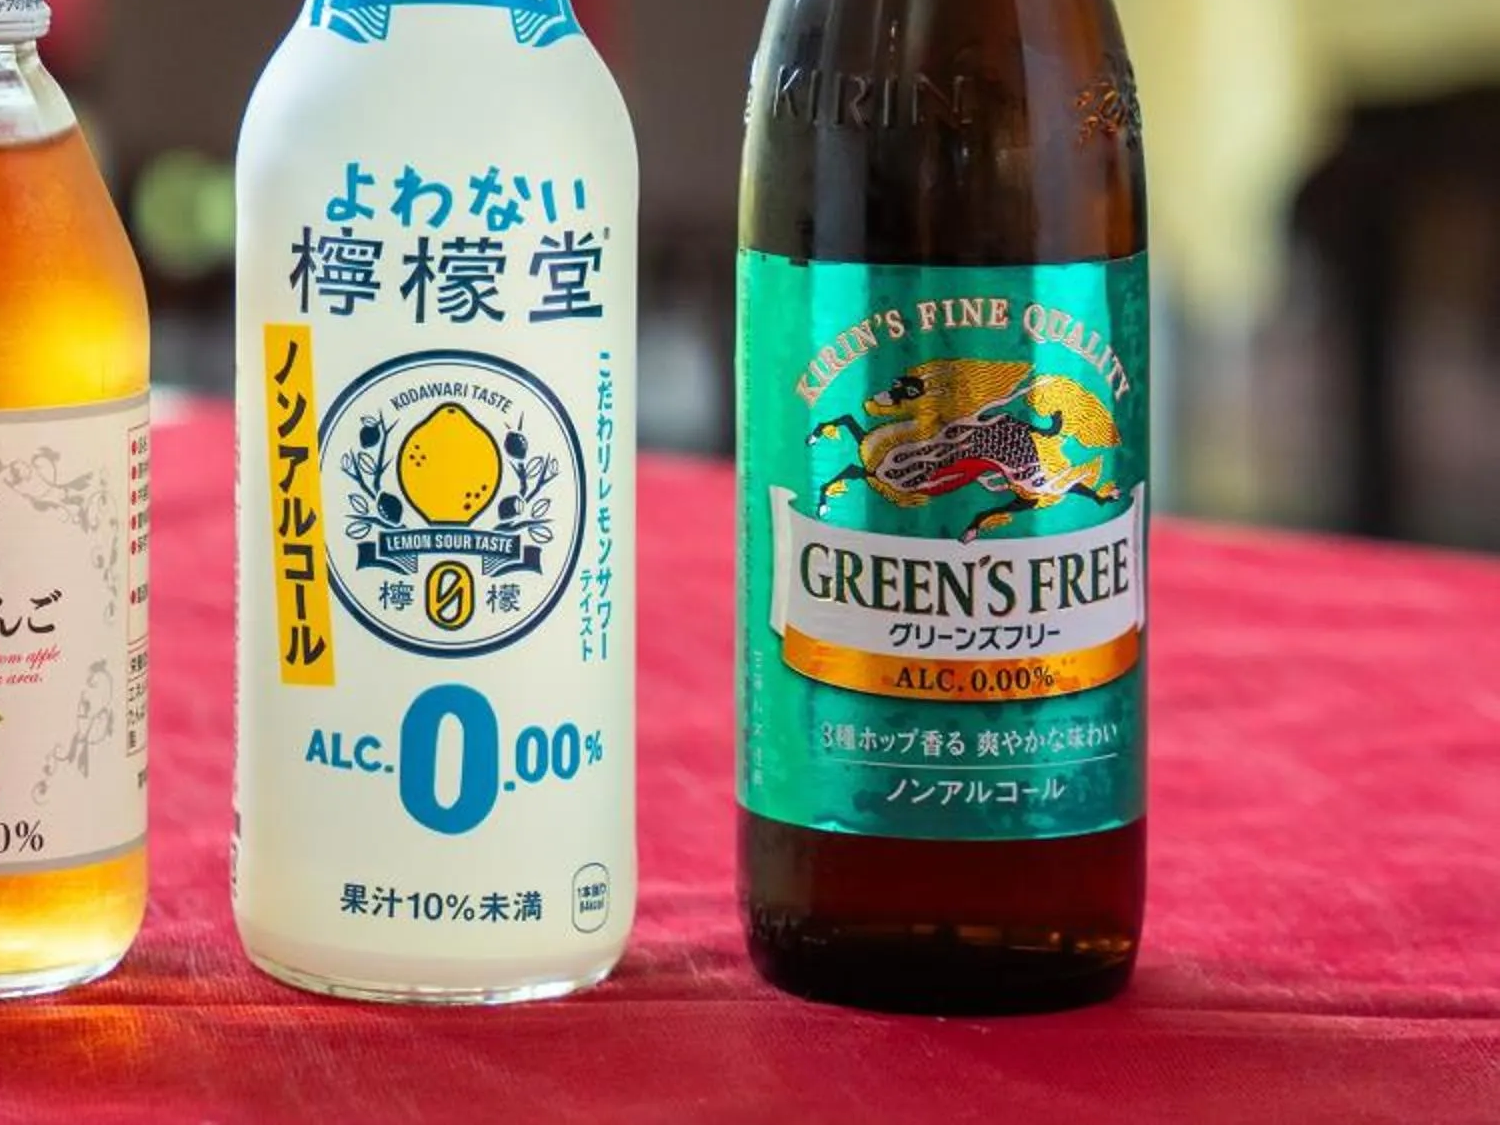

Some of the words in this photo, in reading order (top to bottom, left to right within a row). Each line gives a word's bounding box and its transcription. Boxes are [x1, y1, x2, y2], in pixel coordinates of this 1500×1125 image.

[325, 162, 585, 232] よわない
[289, 226, 603, 323] 檸檬堂
[796, 309, 906, 408] KIRIN'S
[917, 297, 1010, 331] FINE
[1022, 302, 1131, 403] QUALITY
[390, 382, 469, 412] KODAWARI
[471, 383, 514, 414] TASTE
[274, 339, 326, 667] ノンアルコール
[596, 351, 613, 661] こだわりレモンサワー
[386, 533, 431, 553] LEMON
[434, 532, 472, 551] SOUR
[474, 534, 514, 554] TASTE
[799, 542, 1017, 618] GREEN'S
[1027, 536, 1130, 614] FREE
[579, 569, 594, 663] テイスト
[888, 623, 1061, 650] グリーンズフリー
[894, 666, 964, 693] ALC.
[969, 666, 1056, 693] 0.00%
[820, 725, 967, 757] 3種ホップ香る
[976, 724, 1118, 756] 爽やかな味わい
[886, 778, 1066, 805] ノンアルコール
[339, 882, 543, 923] 果汁10%未満
